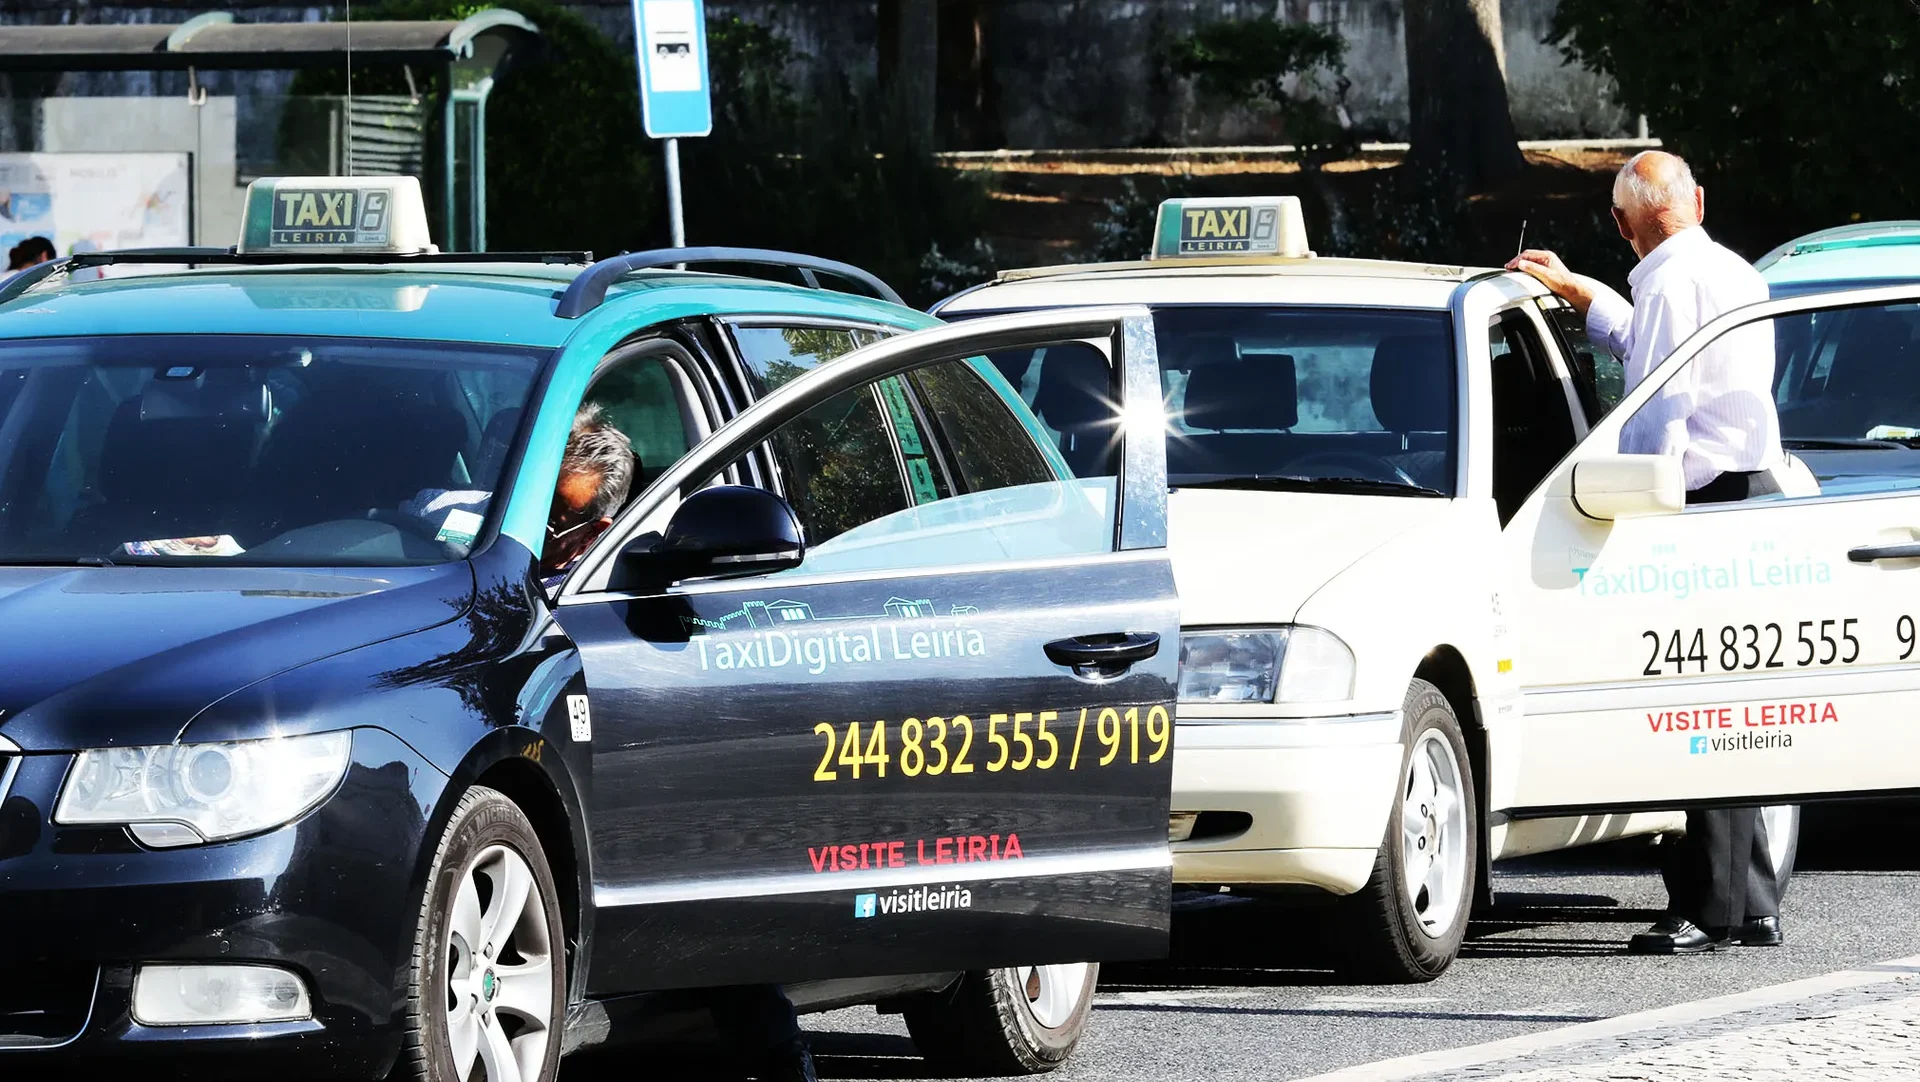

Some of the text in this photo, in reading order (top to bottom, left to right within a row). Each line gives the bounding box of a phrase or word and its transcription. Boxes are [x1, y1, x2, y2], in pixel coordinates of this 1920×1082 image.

[280, 192, 353, 226] TAXI
[1186, 209, 1248, 238] TAXI
[281, 232, 347, 243] LEIRIA
[1188, 241, 1243, 251] LEIRIA
[1749, 556, 1831, 589] Leiria
[689, 620, 986, 675] TaxiDigital Leiria
[1641, 628, 1708, 676] 244
[1719, 622, 1784, 671] 832
[1796, 618, 1860, 666] 555
[1647, 702, 1839, 733] VISITE LEIRIA
[813, 719, 890, 782] 244
[900, 714, 974, 777] 832
[986, 710, 1059, 773] 555
[1096, 704, 1170, 767] 919
[1711, 730, 1793, 751] visitleiria
[808, 833, 1025, 873] VISITE LEIRIA
[879, 885, 972, 914] visitleiria
